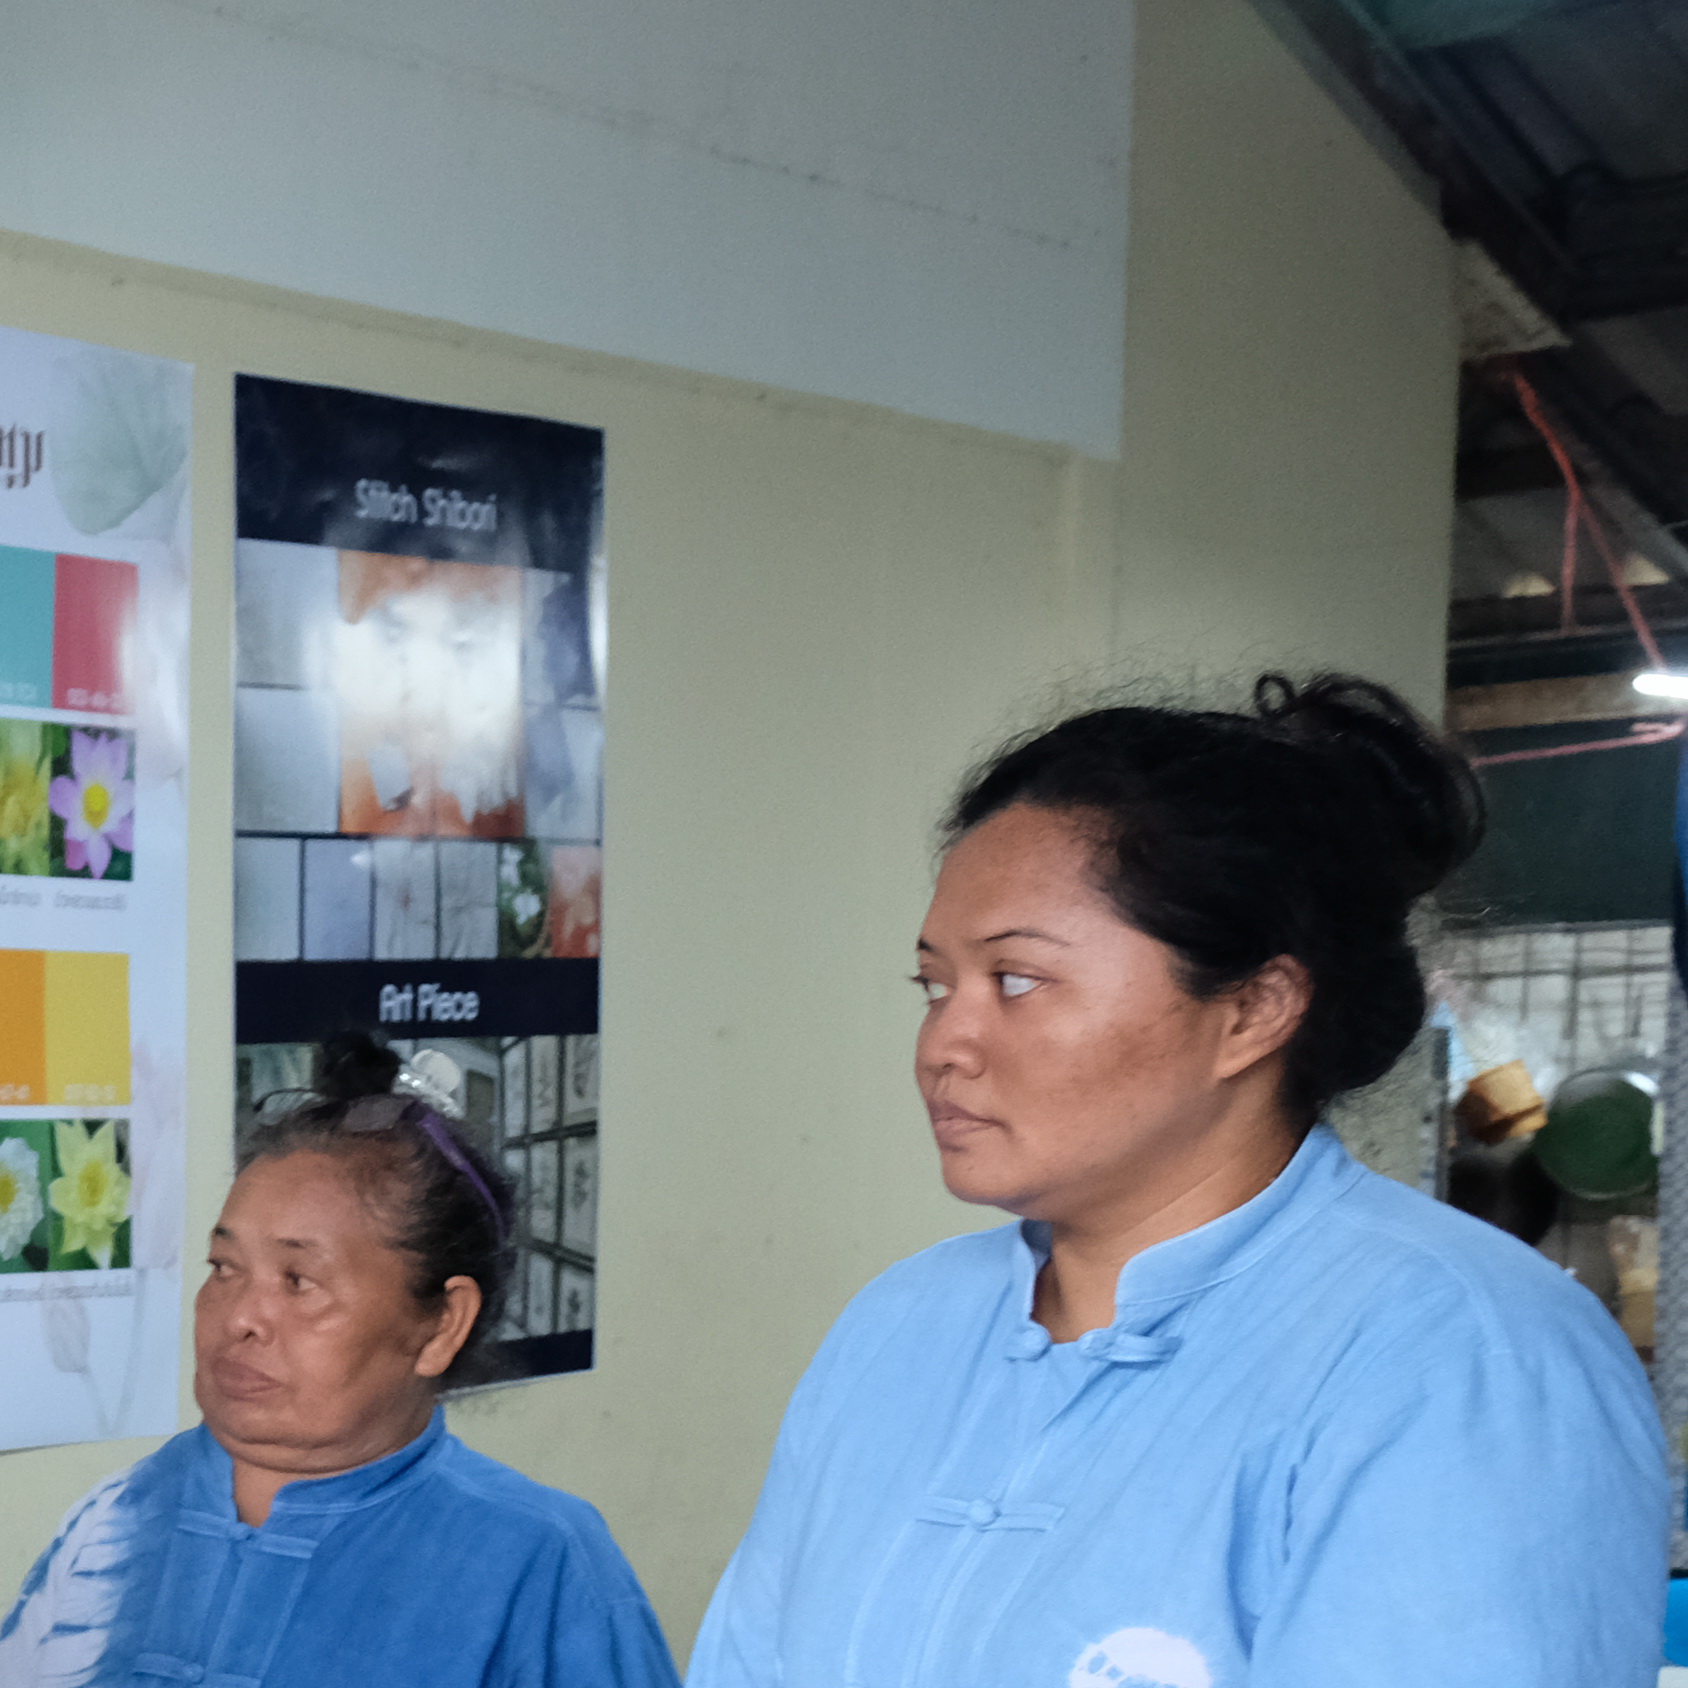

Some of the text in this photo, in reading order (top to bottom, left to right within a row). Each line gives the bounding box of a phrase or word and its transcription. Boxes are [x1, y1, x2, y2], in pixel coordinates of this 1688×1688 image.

[355, 478, 497, 532] Stitch Shibori
[379, 983, 480, 1022] Art Piece
